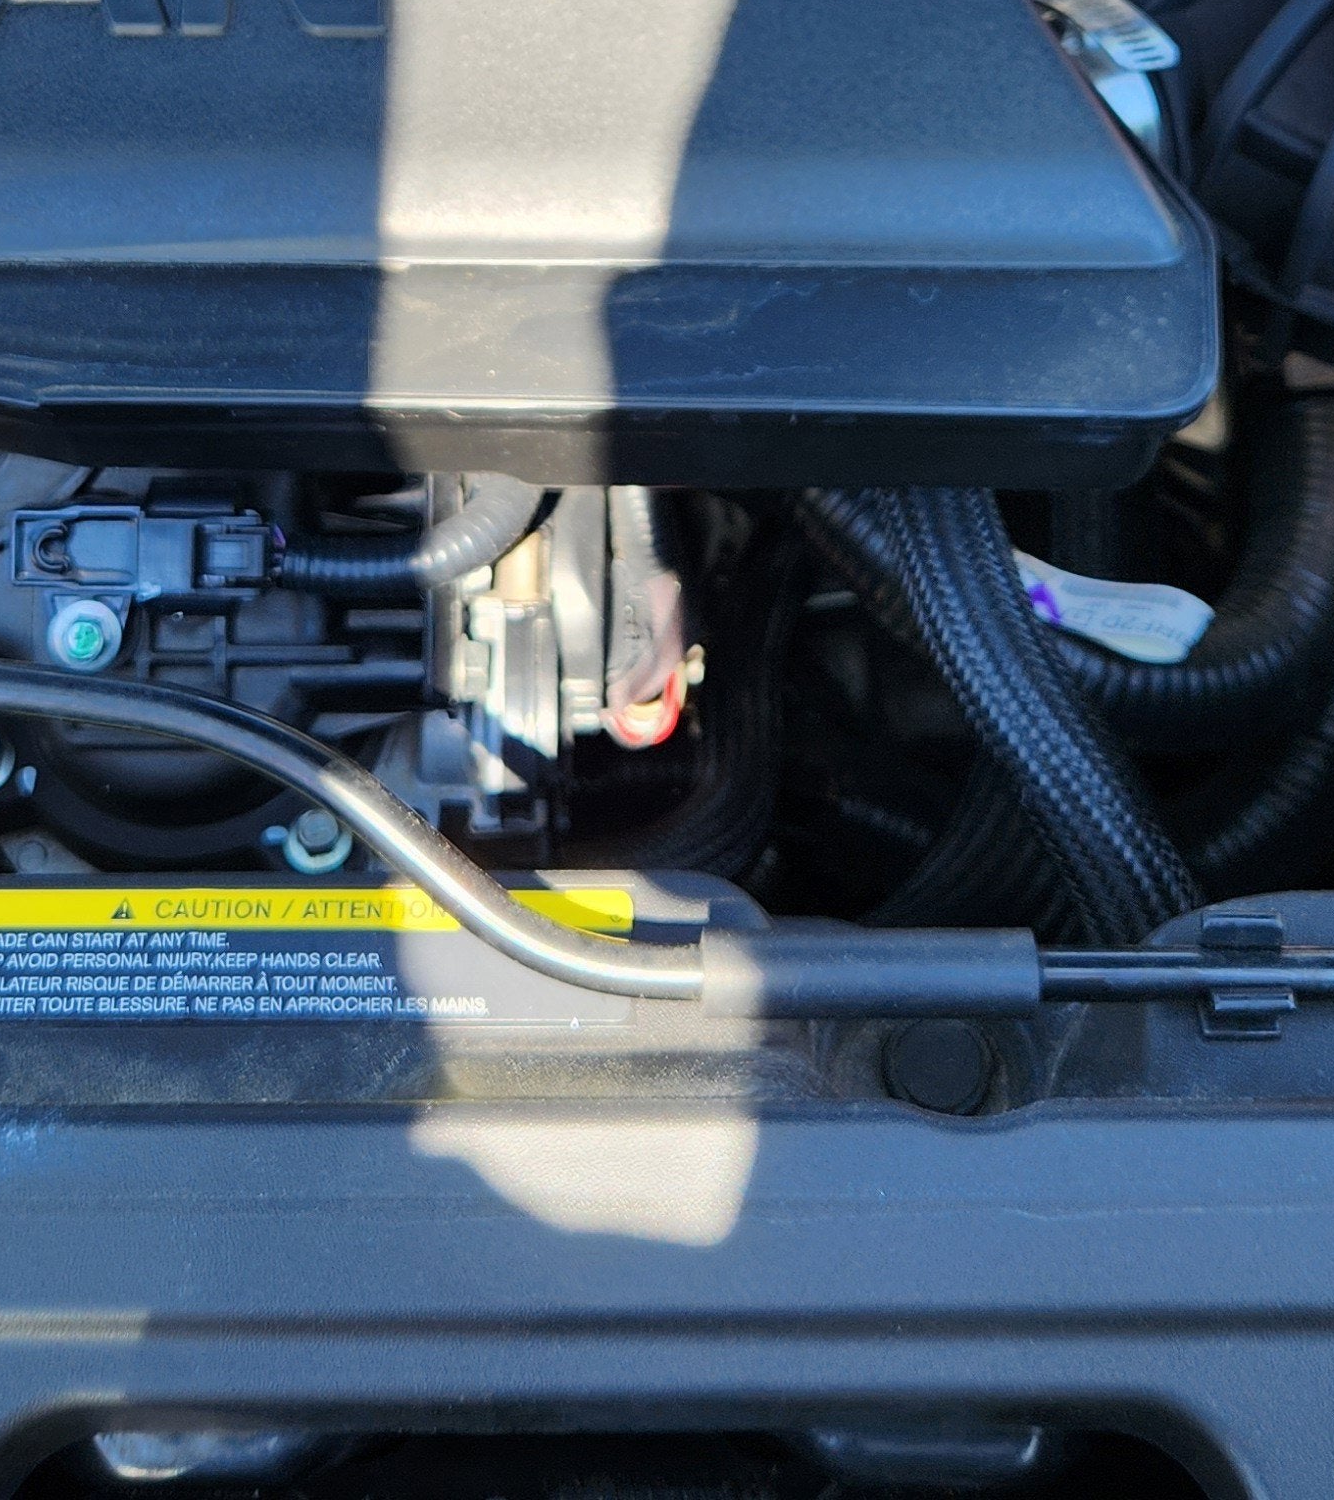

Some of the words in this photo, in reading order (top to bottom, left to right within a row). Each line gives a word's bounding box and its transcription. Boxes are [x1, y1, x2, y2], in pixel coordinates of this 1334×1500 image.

[155, 899, 273, 919] CAUTION
[31, 933, 68, 948] CAN
[71, 933, 126, 948] START
[128, 933, 149, 948] AT
[149, 933, 186, 947] ANY
[187, 933, 230, 947] TIME.
[8, 953, 59, 968] AVOID
[62, 953, 152, 968] PERSONAL
[260, 953, 320, 968] HANDS
[324, 953, 383, 968] CLEAR.
[66, 976, 130, 992] RISQUE
[134, 976, 158, 991] DE
[161, 971, 256, 991] DÉMARRER
[255, 972, 269, 991] À
[272, 976, 318, 991] TOUT
[320, 976, 398, 992] MOMENT.
[40, 998, 95, 1013] TOUTE
[97, 997, 190, 1014] BLESSURE,
[194, 997, 218, 1012] NE
[221, 997, 256, 1012] PAS
[258, 997, 282, 1012] EN
[283, 997, 396, 1012] APPROCHER
[397, 997, 428, 1012] LES
[430, 997, 489, 1015] MAINS.
